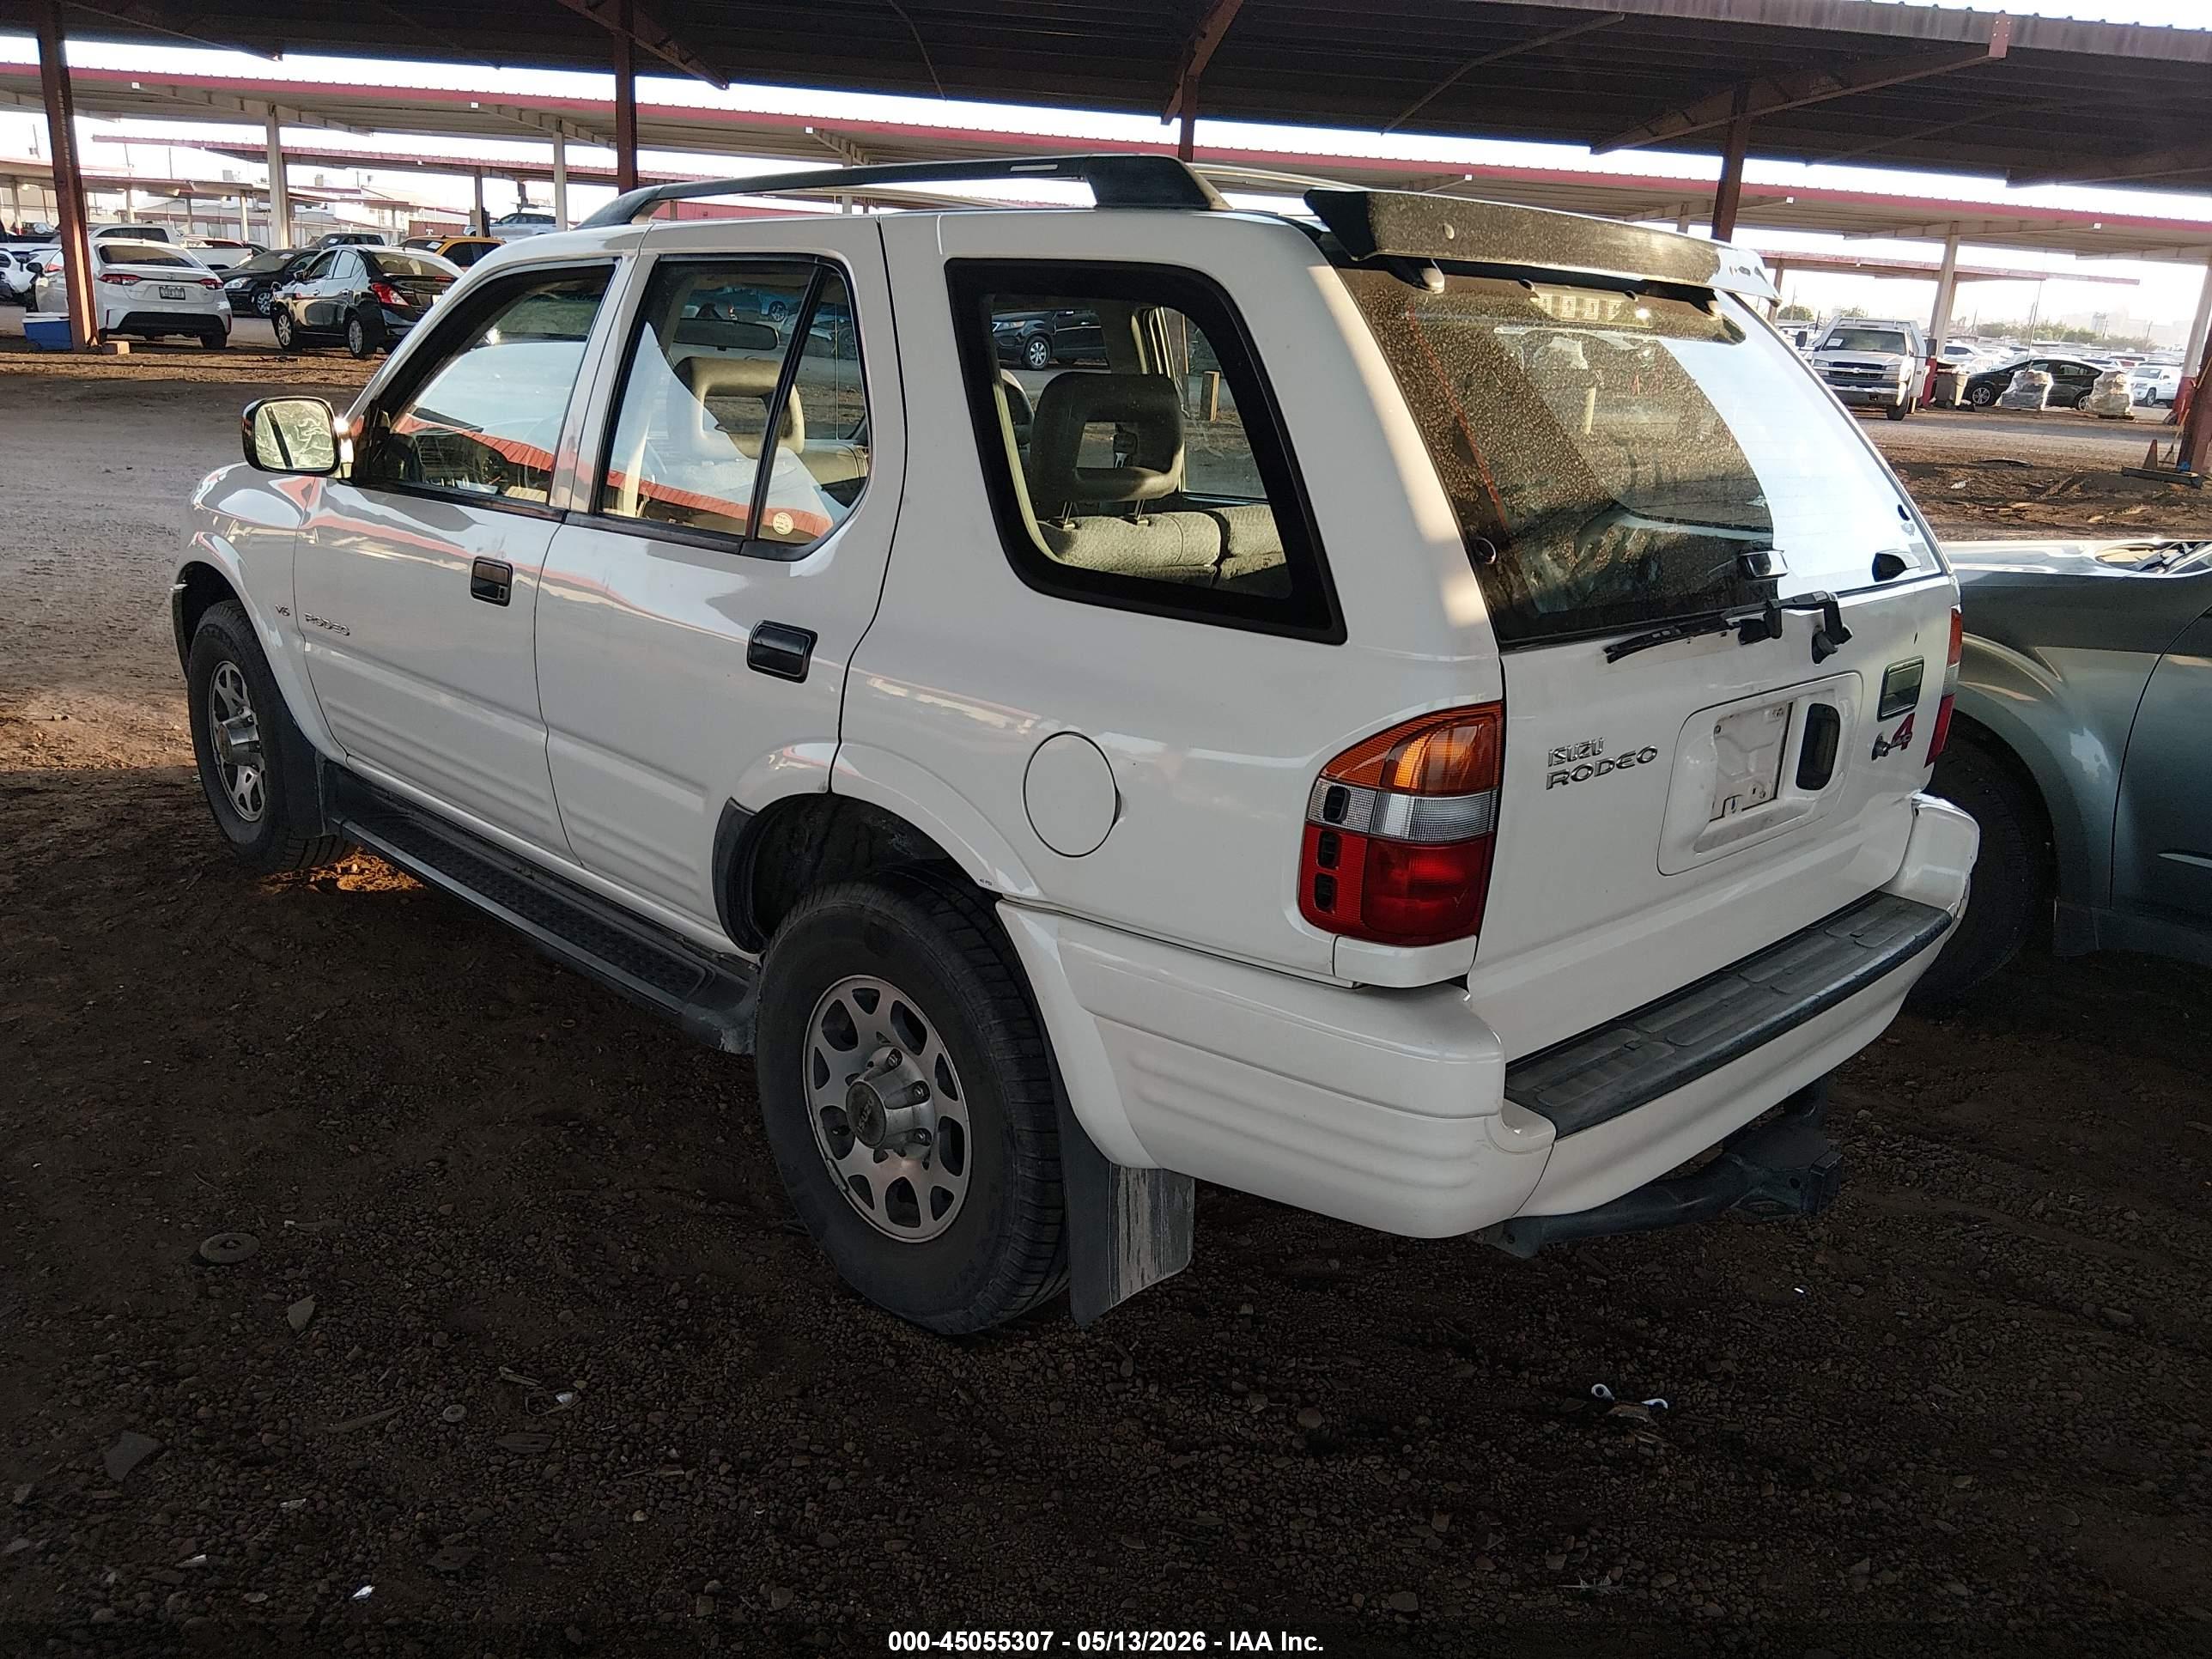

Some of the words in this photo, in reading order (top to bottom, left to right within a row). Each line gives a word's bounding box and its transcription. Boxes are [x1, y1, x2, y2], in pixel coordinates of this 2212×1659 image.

[276, 604, 291, 617] V6
[304, 612, 350, 636] RODEO
[1548, 737, 1604, 769] ISUZU
[1546, 744, 1658, 791] RODEO
